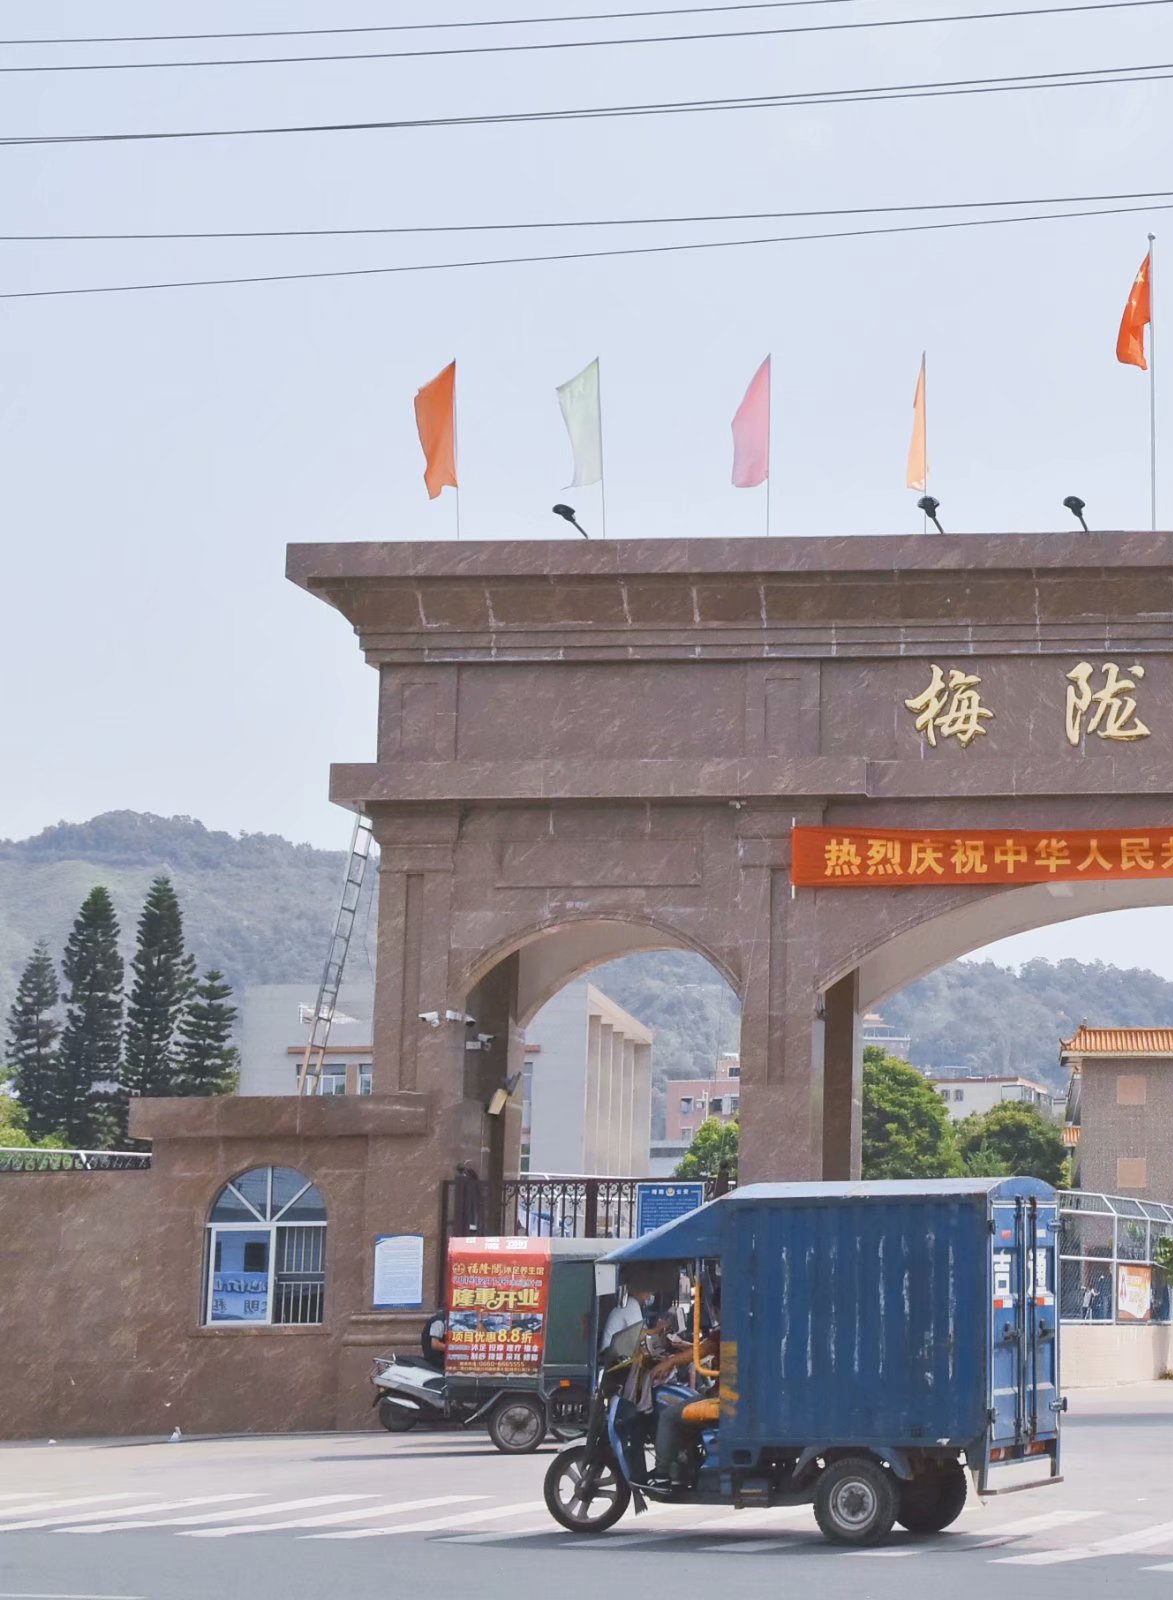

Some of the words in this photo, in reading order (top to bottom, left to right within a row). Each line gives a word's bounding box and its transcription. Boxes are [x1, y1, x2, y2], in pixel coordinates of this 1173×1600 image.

[452, 1287, 540, 1310] 隆重开业
[452, 1328, 534, 1343] 项目优惠8.8折
